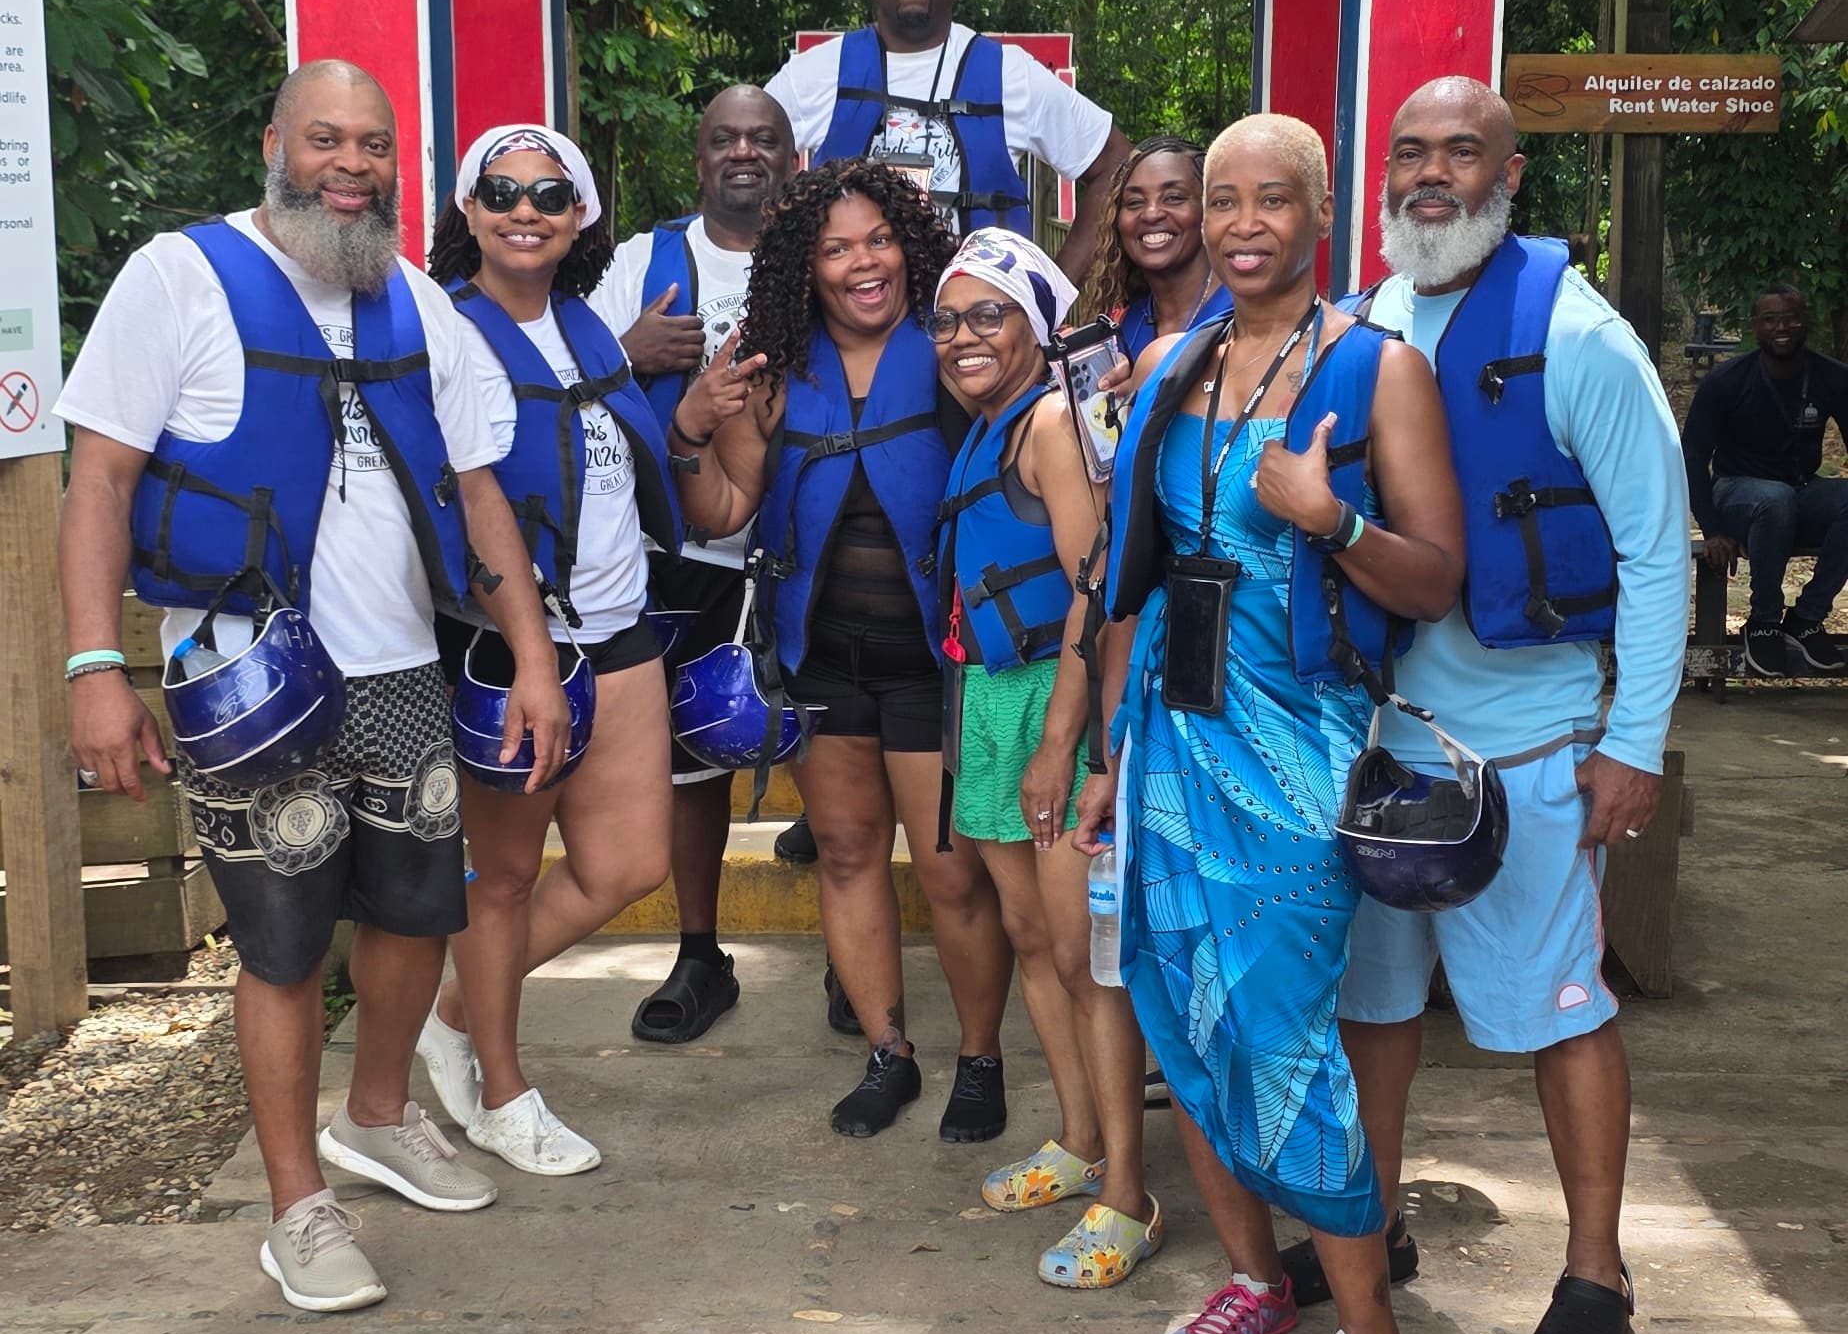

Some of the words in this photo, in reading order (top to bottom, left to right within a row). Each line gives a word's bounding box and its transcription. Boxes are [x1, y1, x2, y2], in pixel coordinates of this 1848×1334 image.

[5, 46, 24, 57] are
[1584, 75, 1663, 94] Alquiler
[1668, 75, 1692, 91] de
[1699, 75, 1776, 91] calzado
[1609, 97, 1655, 114] Rent
[1661, 97, 1720, 114] Water
[1725, 97, 1775, 114] Shoe
[18, 157, 30, 167] or
[356, 455, 390, 468] GREA
[586, 445, 622, 469] 2026
